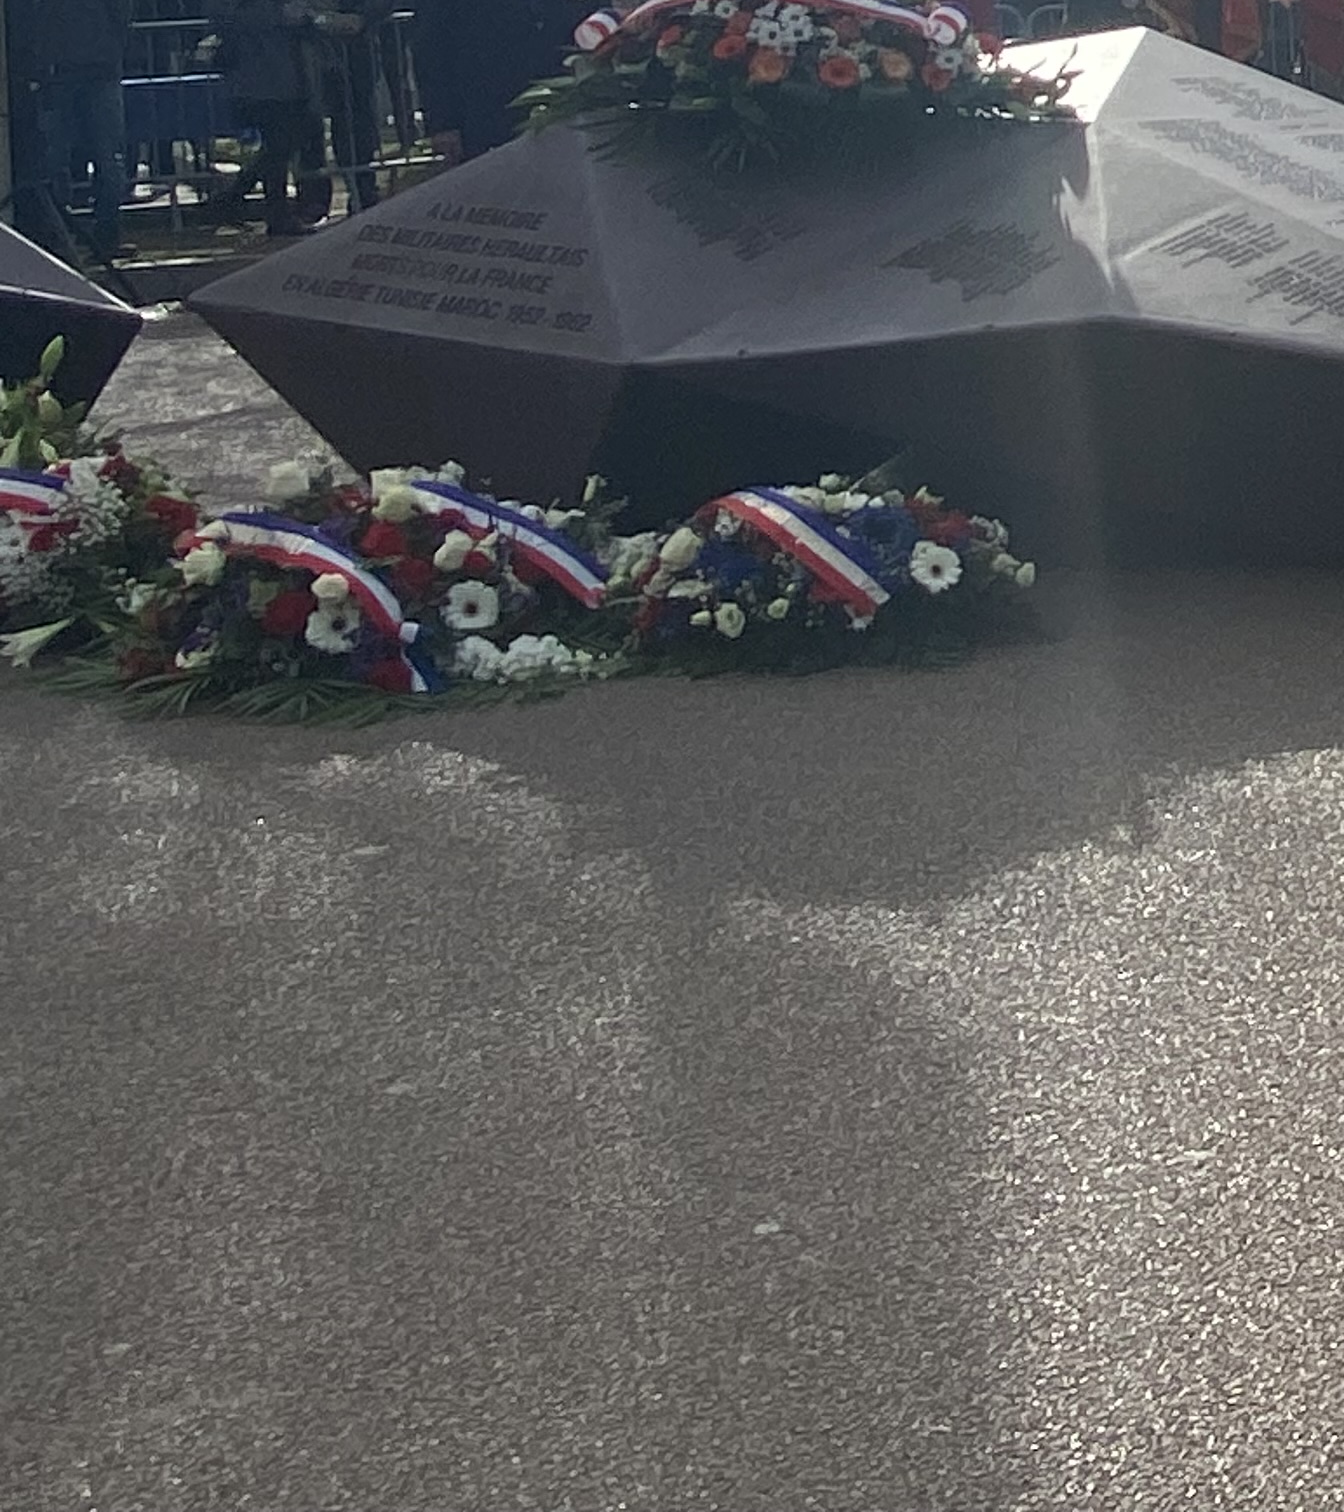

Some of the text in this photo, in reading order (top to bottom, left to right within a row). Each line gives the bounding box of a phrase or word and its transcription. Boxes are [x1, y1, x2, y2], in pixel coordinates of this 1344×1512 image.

[440, 202, 464, 223] LA
[357, 224, 394, 244] DES
[391, 227, 482, 255] MILITAIRES
[351, 253, 554, 295] MORTS POUR LA FRANCE
[281, 273, 307, 293] EN
[373, 285, 438, 311] TUNISIE
[435, 295, 502, 320] MAROC
